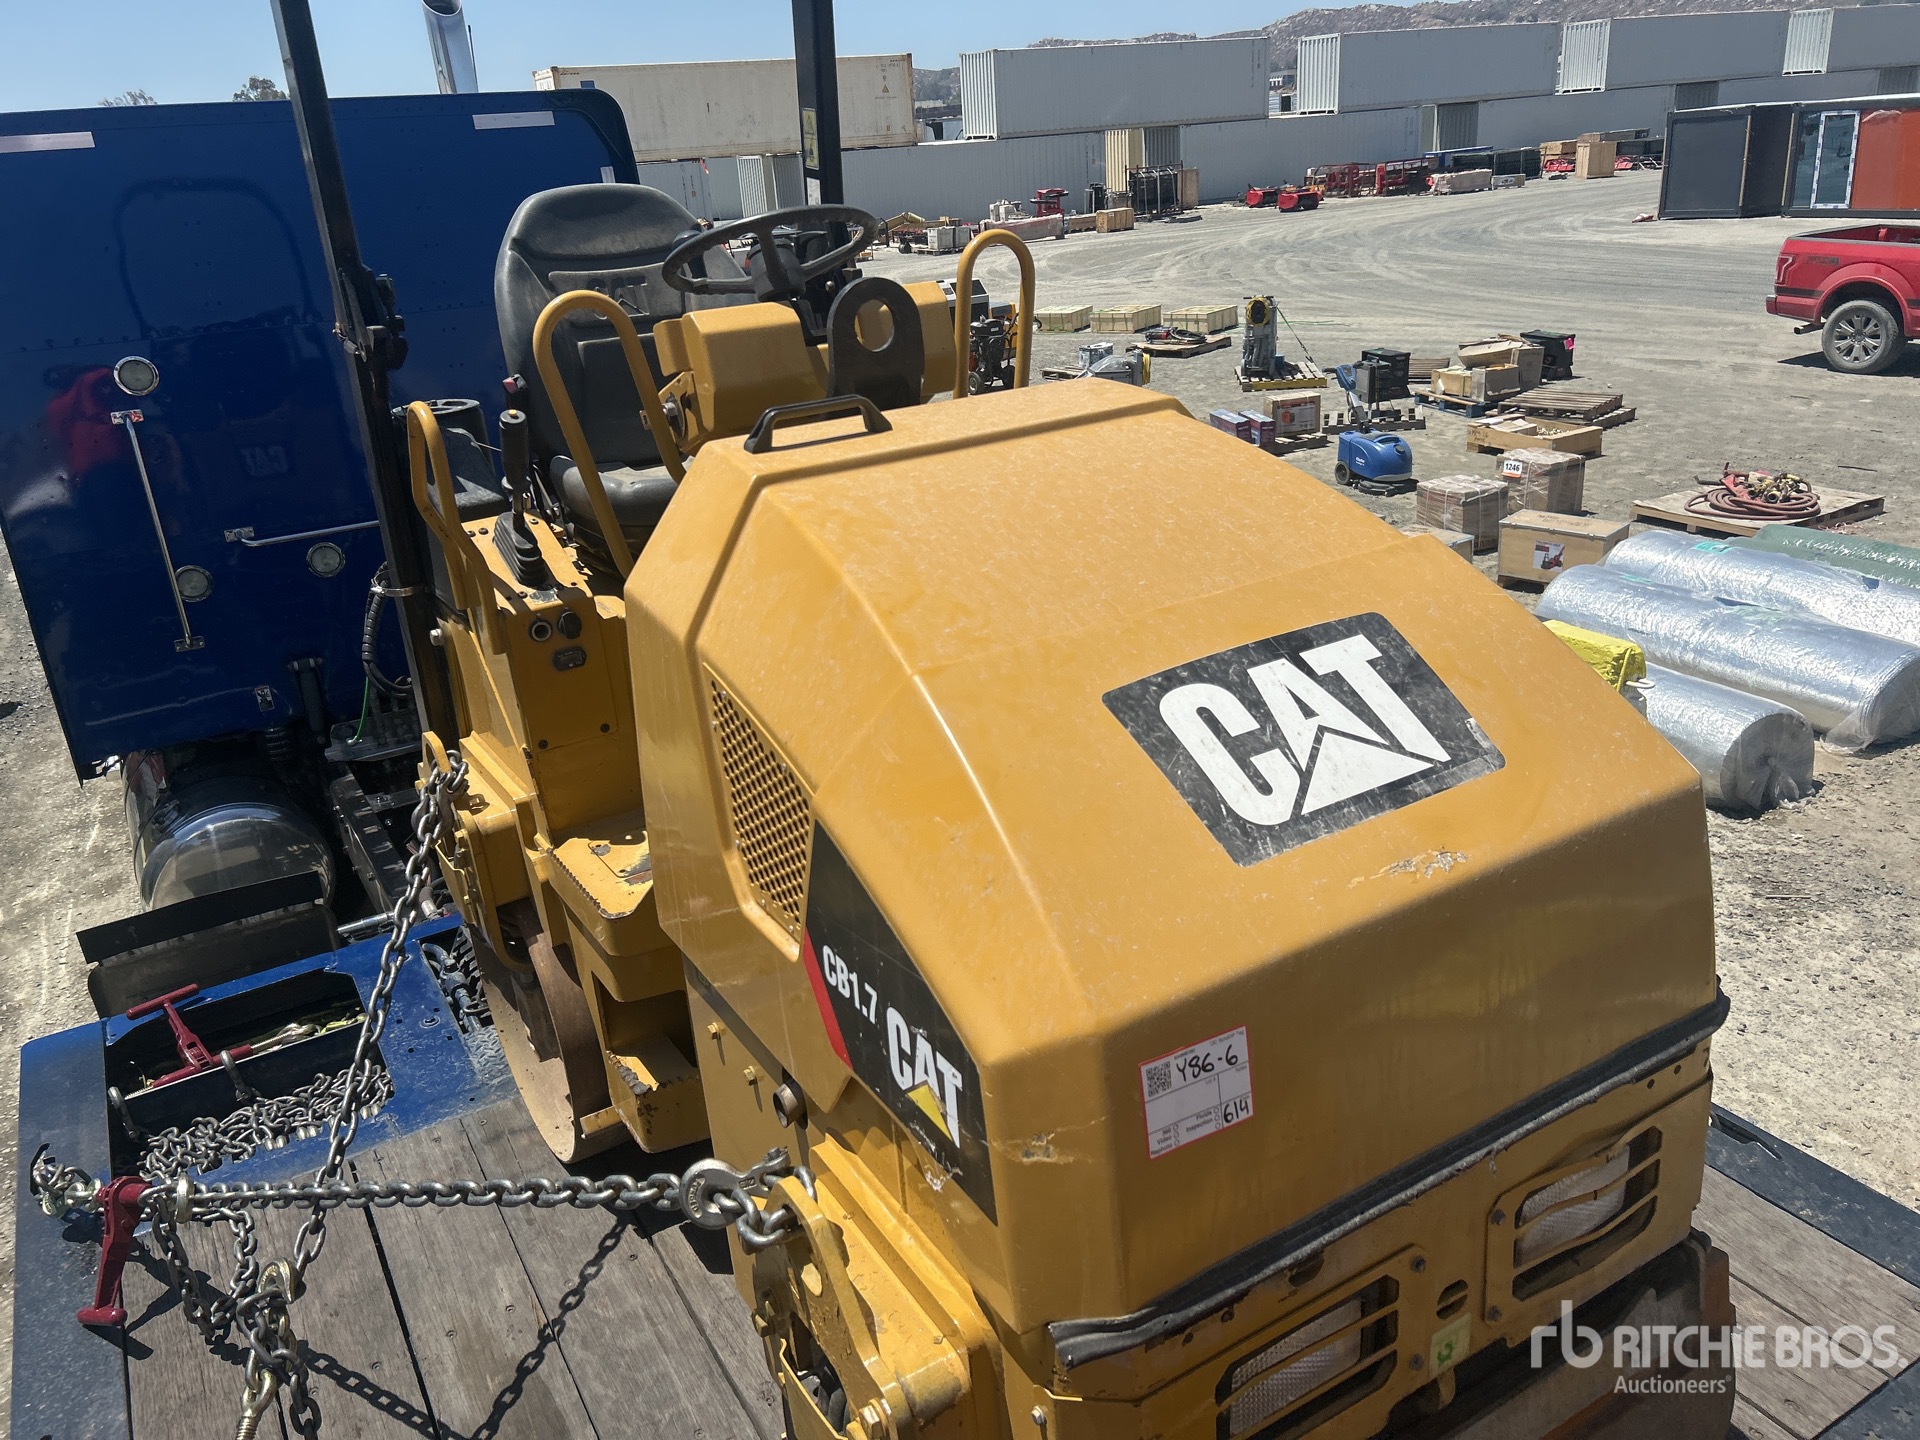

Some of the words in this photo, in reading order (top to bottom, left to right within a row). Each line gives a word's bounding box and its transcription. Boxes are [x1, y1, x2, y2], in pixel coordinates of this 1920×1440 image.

[1505, 462, 1521, 472] 1246
[1159, 633, 1451, 826] CAT
[822, 944, 878, 1025] CB1.7
[886, 1006, 964, 1150] CAT
[1223, 1098, 1250, 1124] 614
